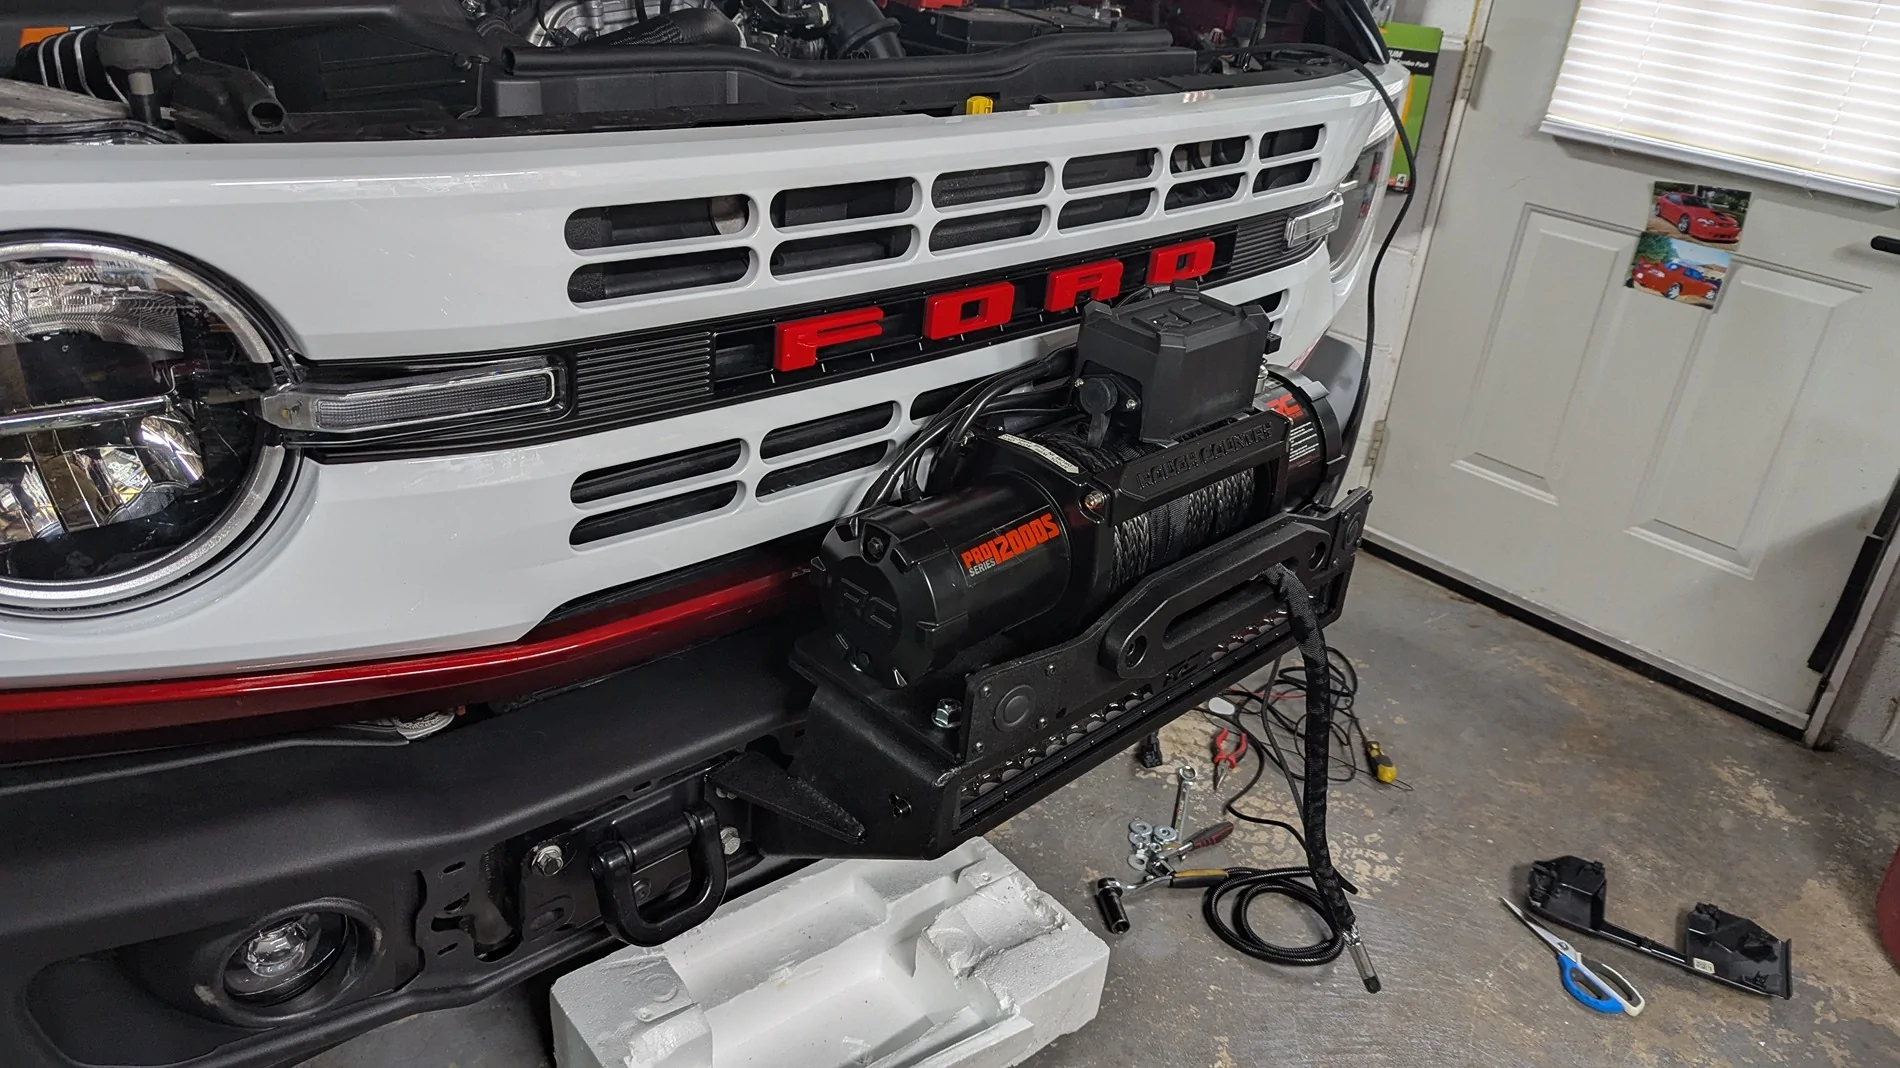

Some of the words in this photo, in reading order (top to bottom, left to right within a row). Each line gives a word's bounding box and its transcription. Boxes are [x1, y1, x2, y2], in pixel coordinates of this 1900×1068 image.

[774, 238, 1216, 372] FORD
[1136, 452, 1198, 489] ROUGH
[1199, 421, 1273, 464] COUNTRY
[961, 542, 993, 569] PRO
[988, 513, 1060, 565] 12000S
[968, 557, 996, 577] SERIES
